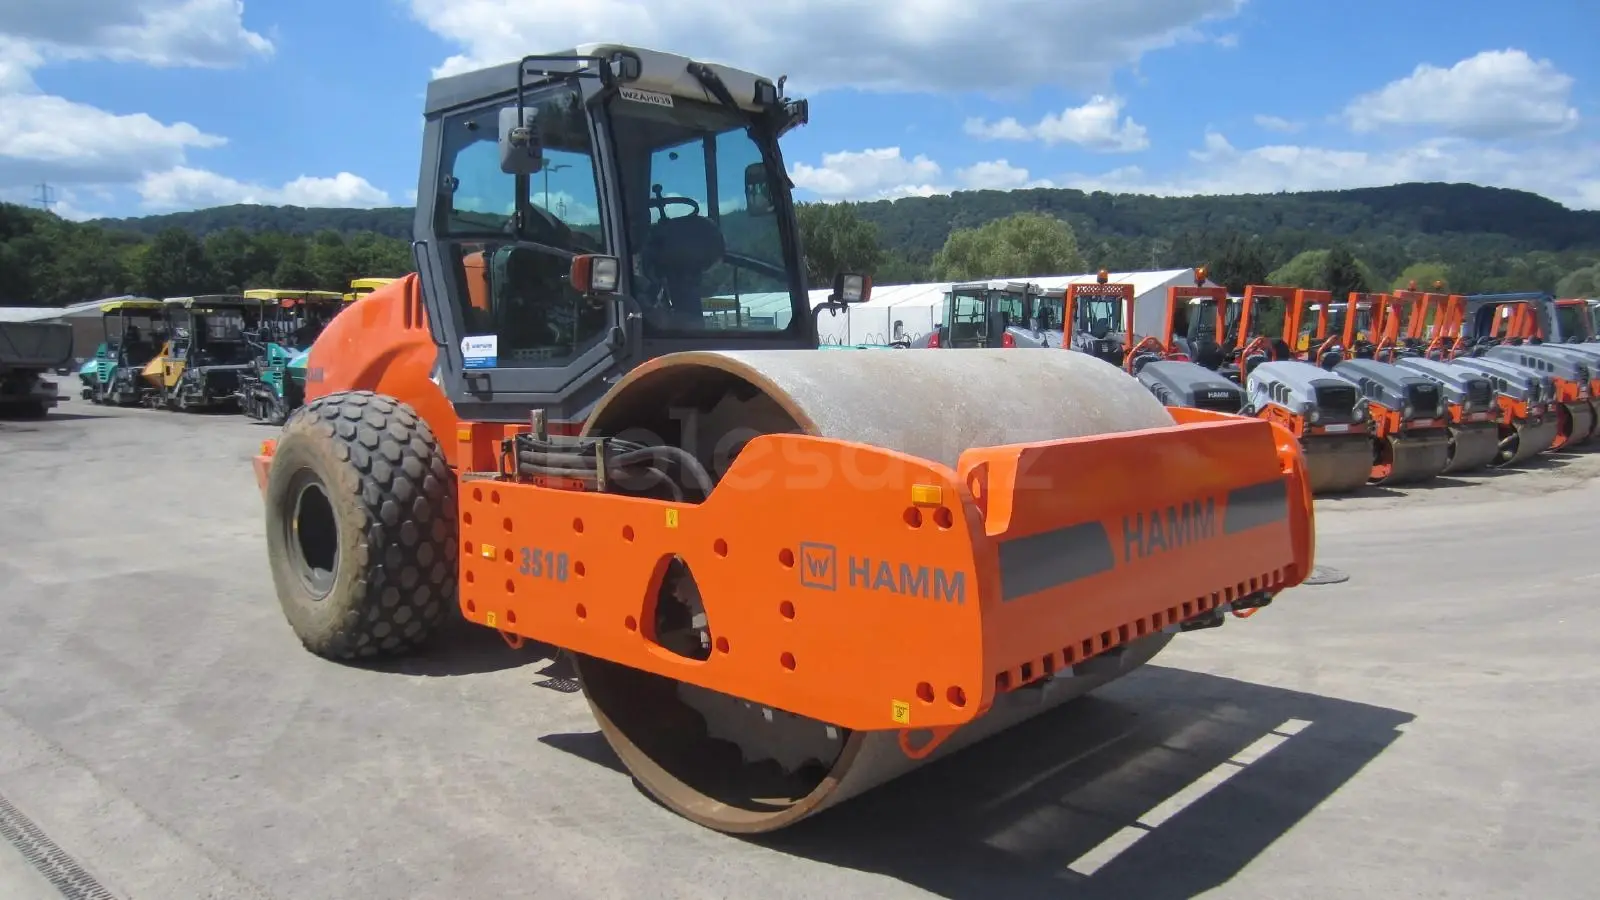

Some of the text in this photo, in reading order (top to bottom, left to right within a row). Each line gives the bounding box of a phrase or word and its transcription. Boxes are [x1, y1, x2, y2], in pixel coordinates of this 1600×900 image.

[1122, 495, 1216, 563] HAMM
[519, 546, 569, 582] 3518
[849, 555, 966, 605] HAMM
